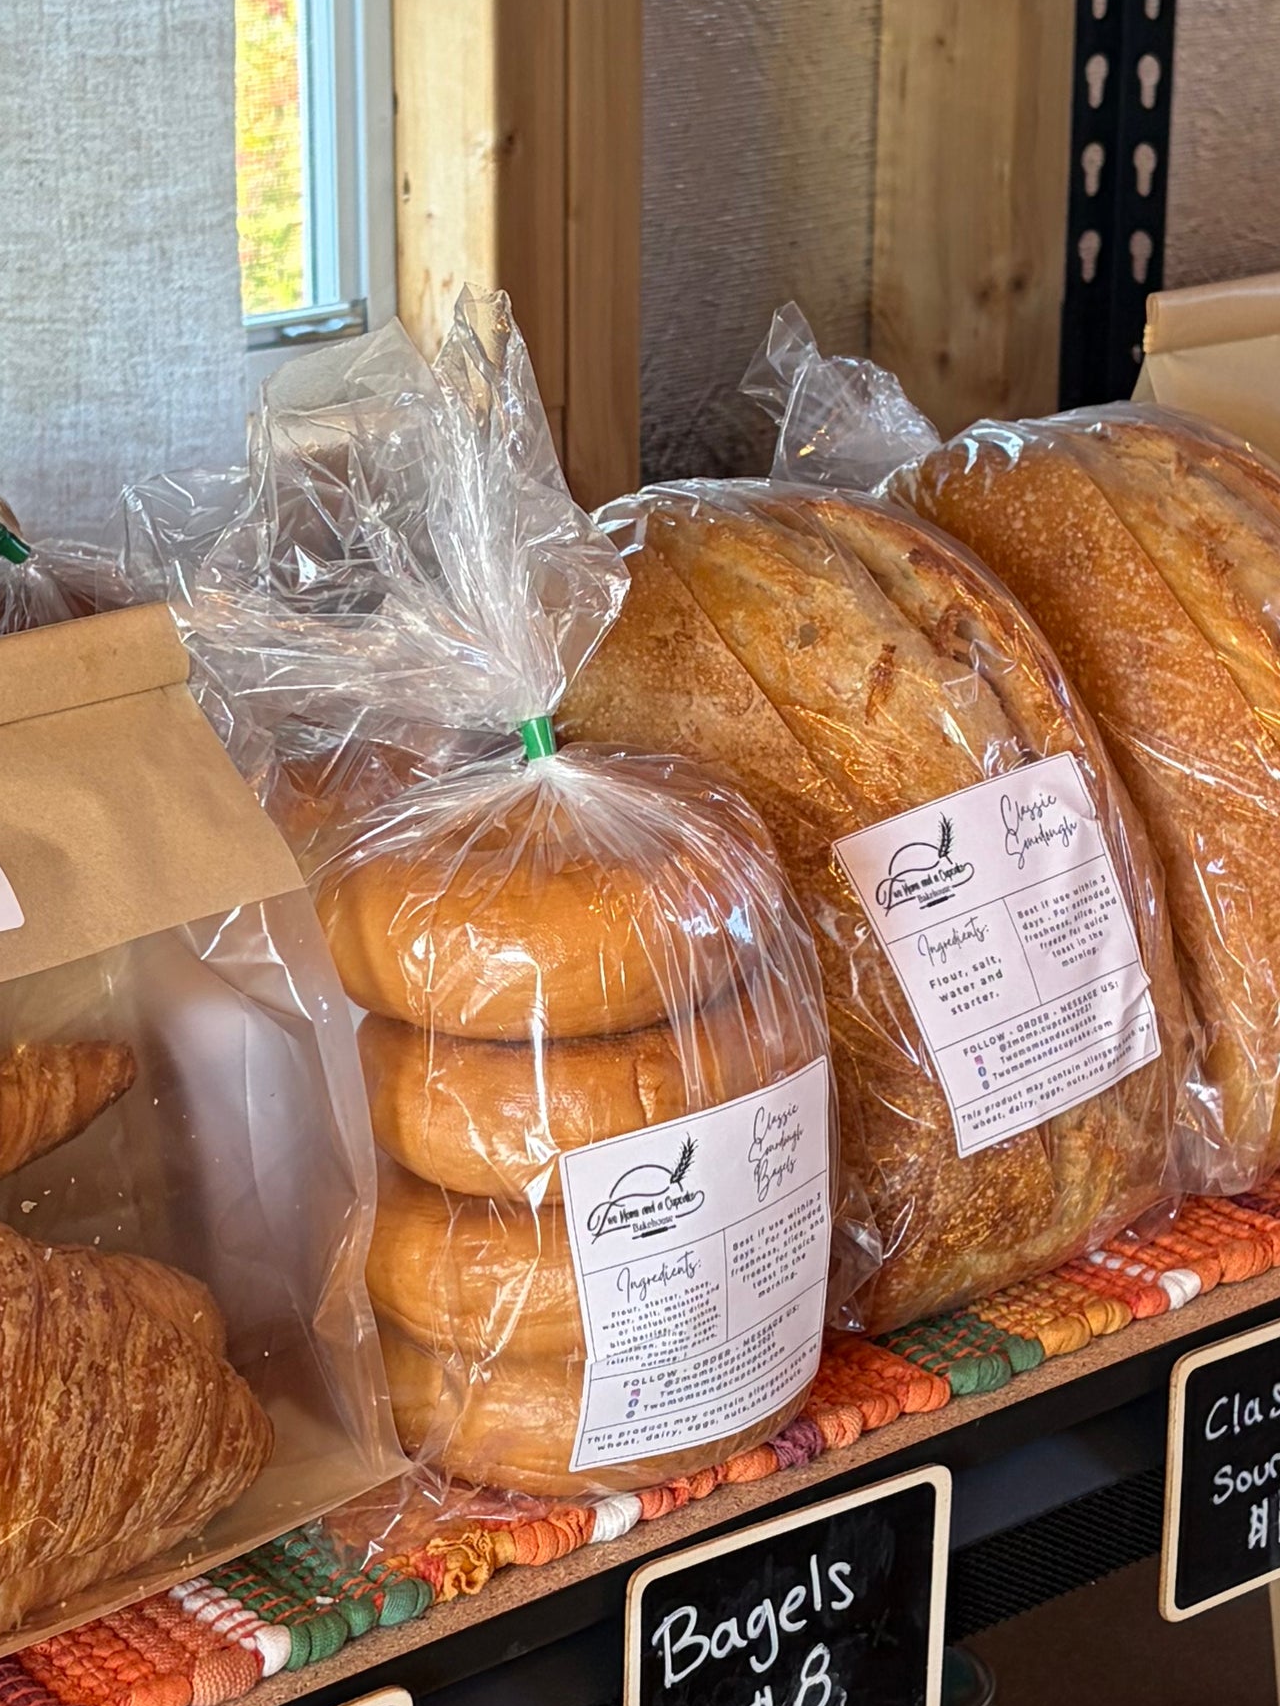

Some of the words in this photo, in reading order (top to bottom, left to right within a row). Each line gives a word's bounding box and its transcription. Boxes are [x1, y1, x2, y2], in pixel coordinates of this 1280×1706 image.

[928, 968, 969, 990] Flour,
[972, 954, 1003, 972] salt,
[938, 981, 976, 1004] water
[979, 969, 1004, 987] and
[650, 1553, 856, 1690] Bagels
